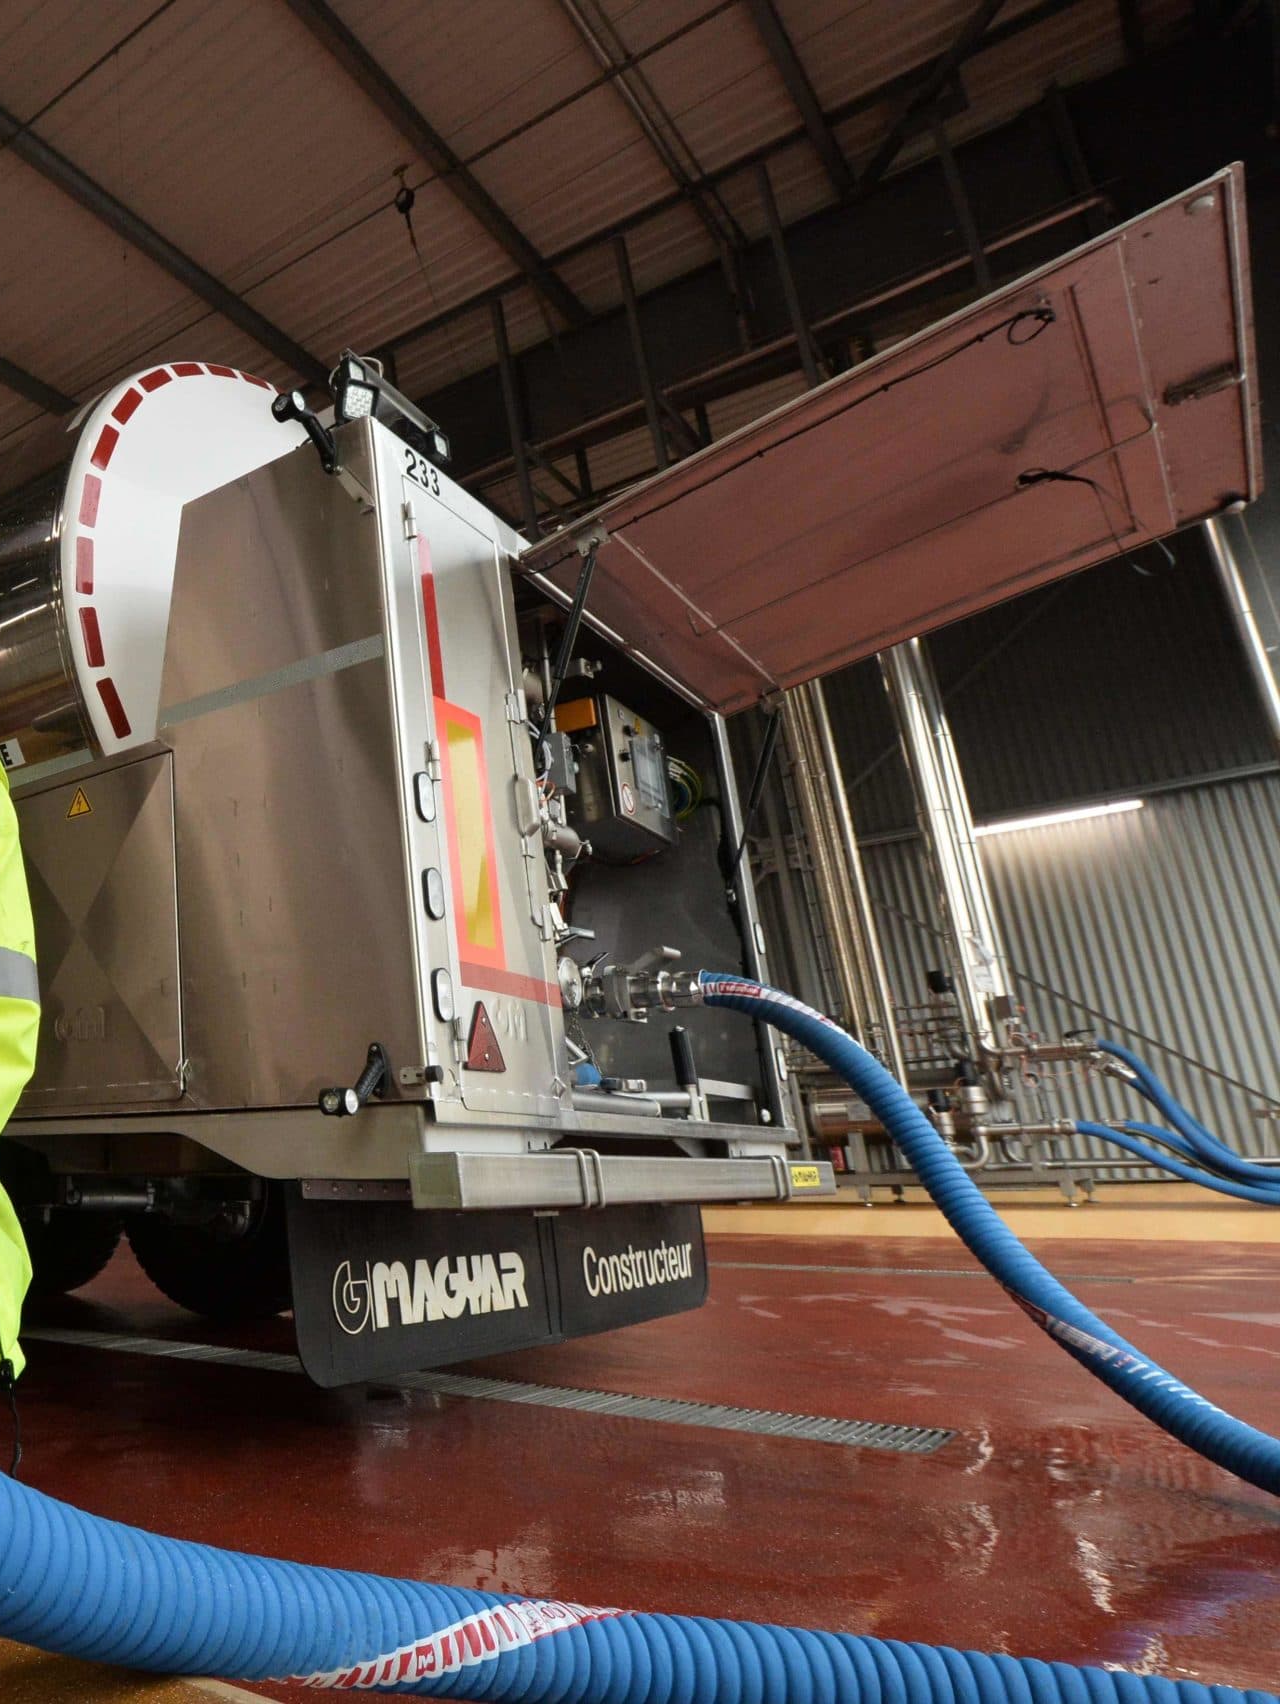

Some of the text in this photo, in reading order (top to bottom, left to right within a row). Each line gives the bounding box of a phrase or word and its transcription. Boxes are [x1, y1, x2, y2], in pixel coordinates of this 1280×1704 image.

[404, 447, 441, 497] 233
[371, 1251, 529, 1329] MAGYAR
[582, 1239, 693, 1298] Constructeur
